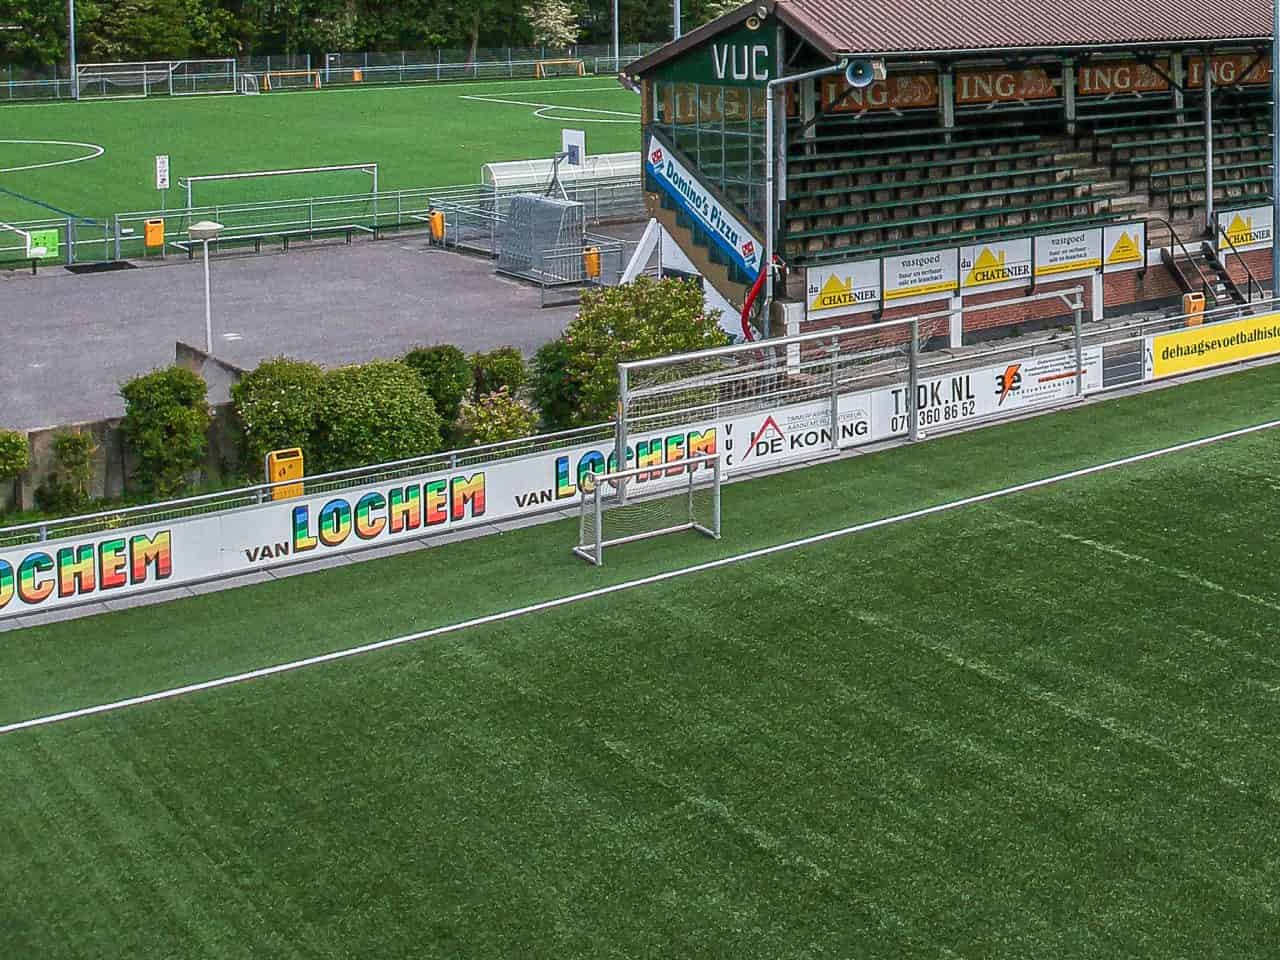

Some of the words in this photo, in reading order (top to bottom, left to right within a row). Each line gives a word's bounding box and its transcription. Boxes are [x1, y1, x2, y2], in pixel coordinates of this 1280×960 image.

[712, 44, 769, 80] VUC
[960, 74, 1016, 99] ING
[1083, 67, 1131, 90] ING
[827, 81, 889, 107] ING
[666, 159, 709, 217] Domino's
[710, 205, 738, 246] Pizza
[960, 258, 971, 268] du
[974, 264, 1030, 282] CHATENIER
[809, 284, 819, 294] du
[822, 290, 877, 306] CHATENIER
[920, 407, 940, 426] 360
[944, 404, 958, 420] 86
[962, 400, 975, 417] 52
[725, 423, 733, 466] VUC
[756, 437, 783, 457] DE
[514, 488, 553, 508] VAN
[555, 428, 716, 500] LOCHEM
[245, 541, 289, 563] VAN
[291, 471, 487, 554] LOCHEM
